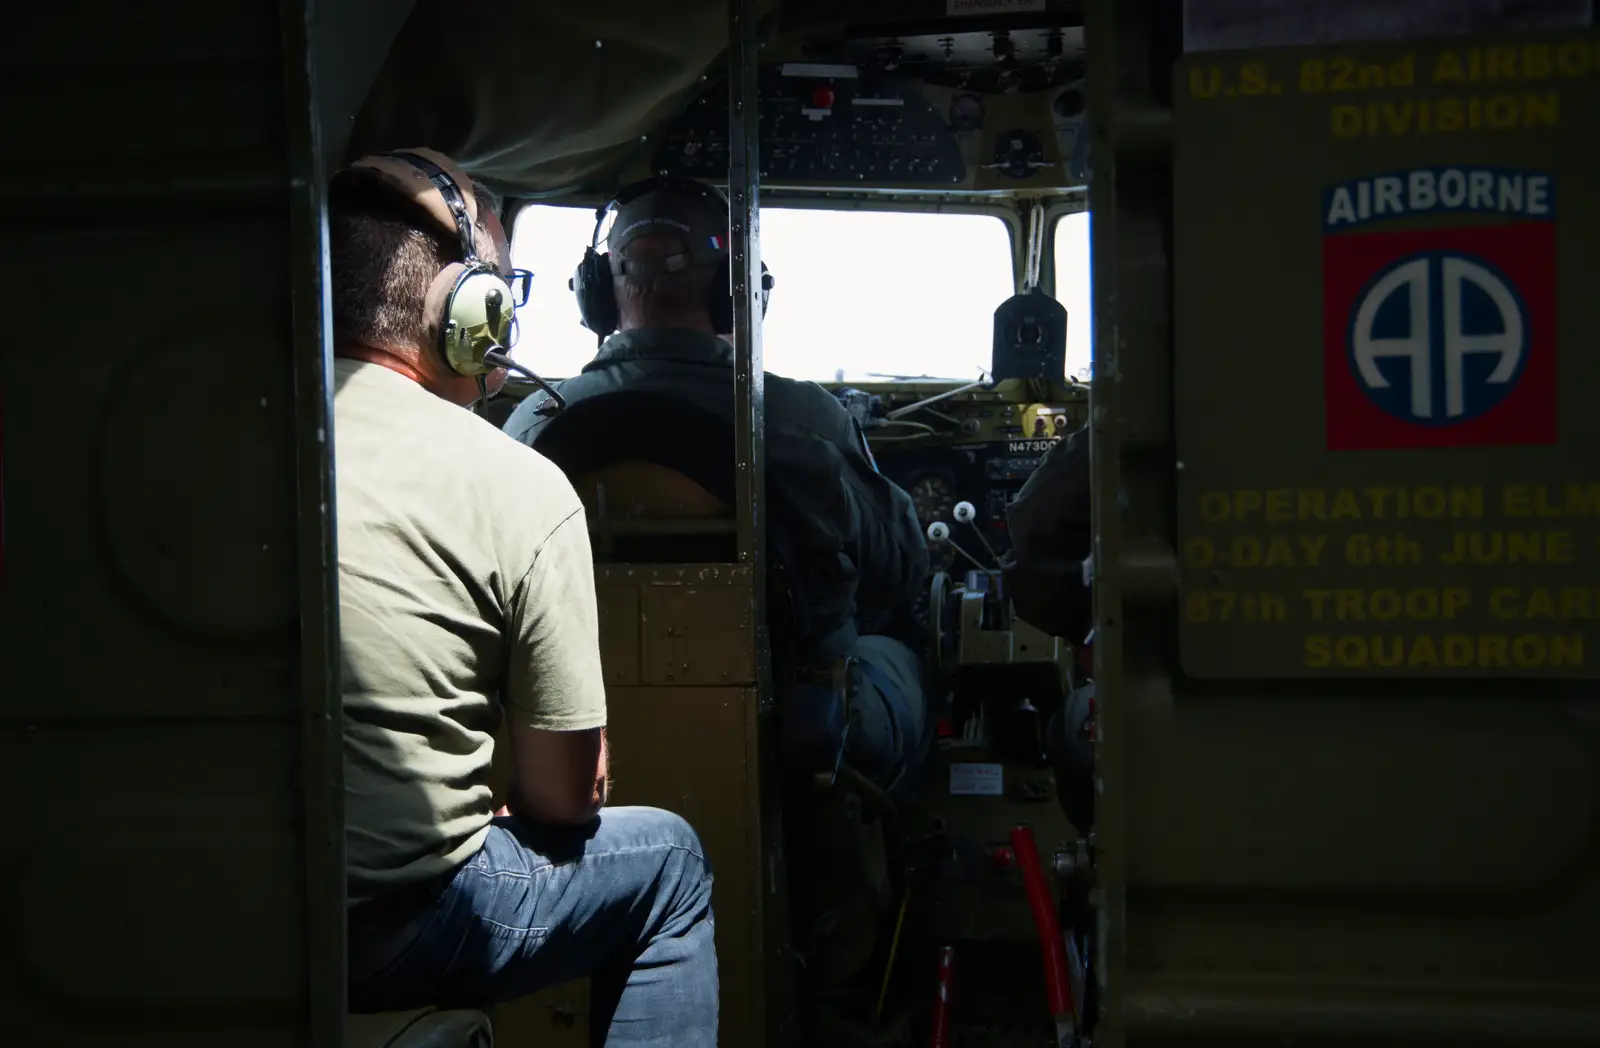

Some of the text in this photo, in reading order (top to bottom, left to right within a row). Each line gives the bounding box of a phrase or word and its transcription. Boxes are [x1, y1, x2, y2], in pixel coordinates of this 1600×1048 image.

[1188, 42, 1600, 99] U.S. 82nd AIRBO
[1331, 92, 1559, 139] DIVISION
[1326, 168, 1550, 225] AIRBORNE
[1352, 256, 1525, 418] AA
[1199, 484, 1484, 522] OPERATION
[1185, 533, 1330, 569] D-DAY
[1345, 532, 1422, 566] 6th
[1438, 530, 1576, 565] JUNE
[1185, 585, 1600, 623] 87th TROOP CAR
[1303, 633, 1584, 669] SQUADRON
